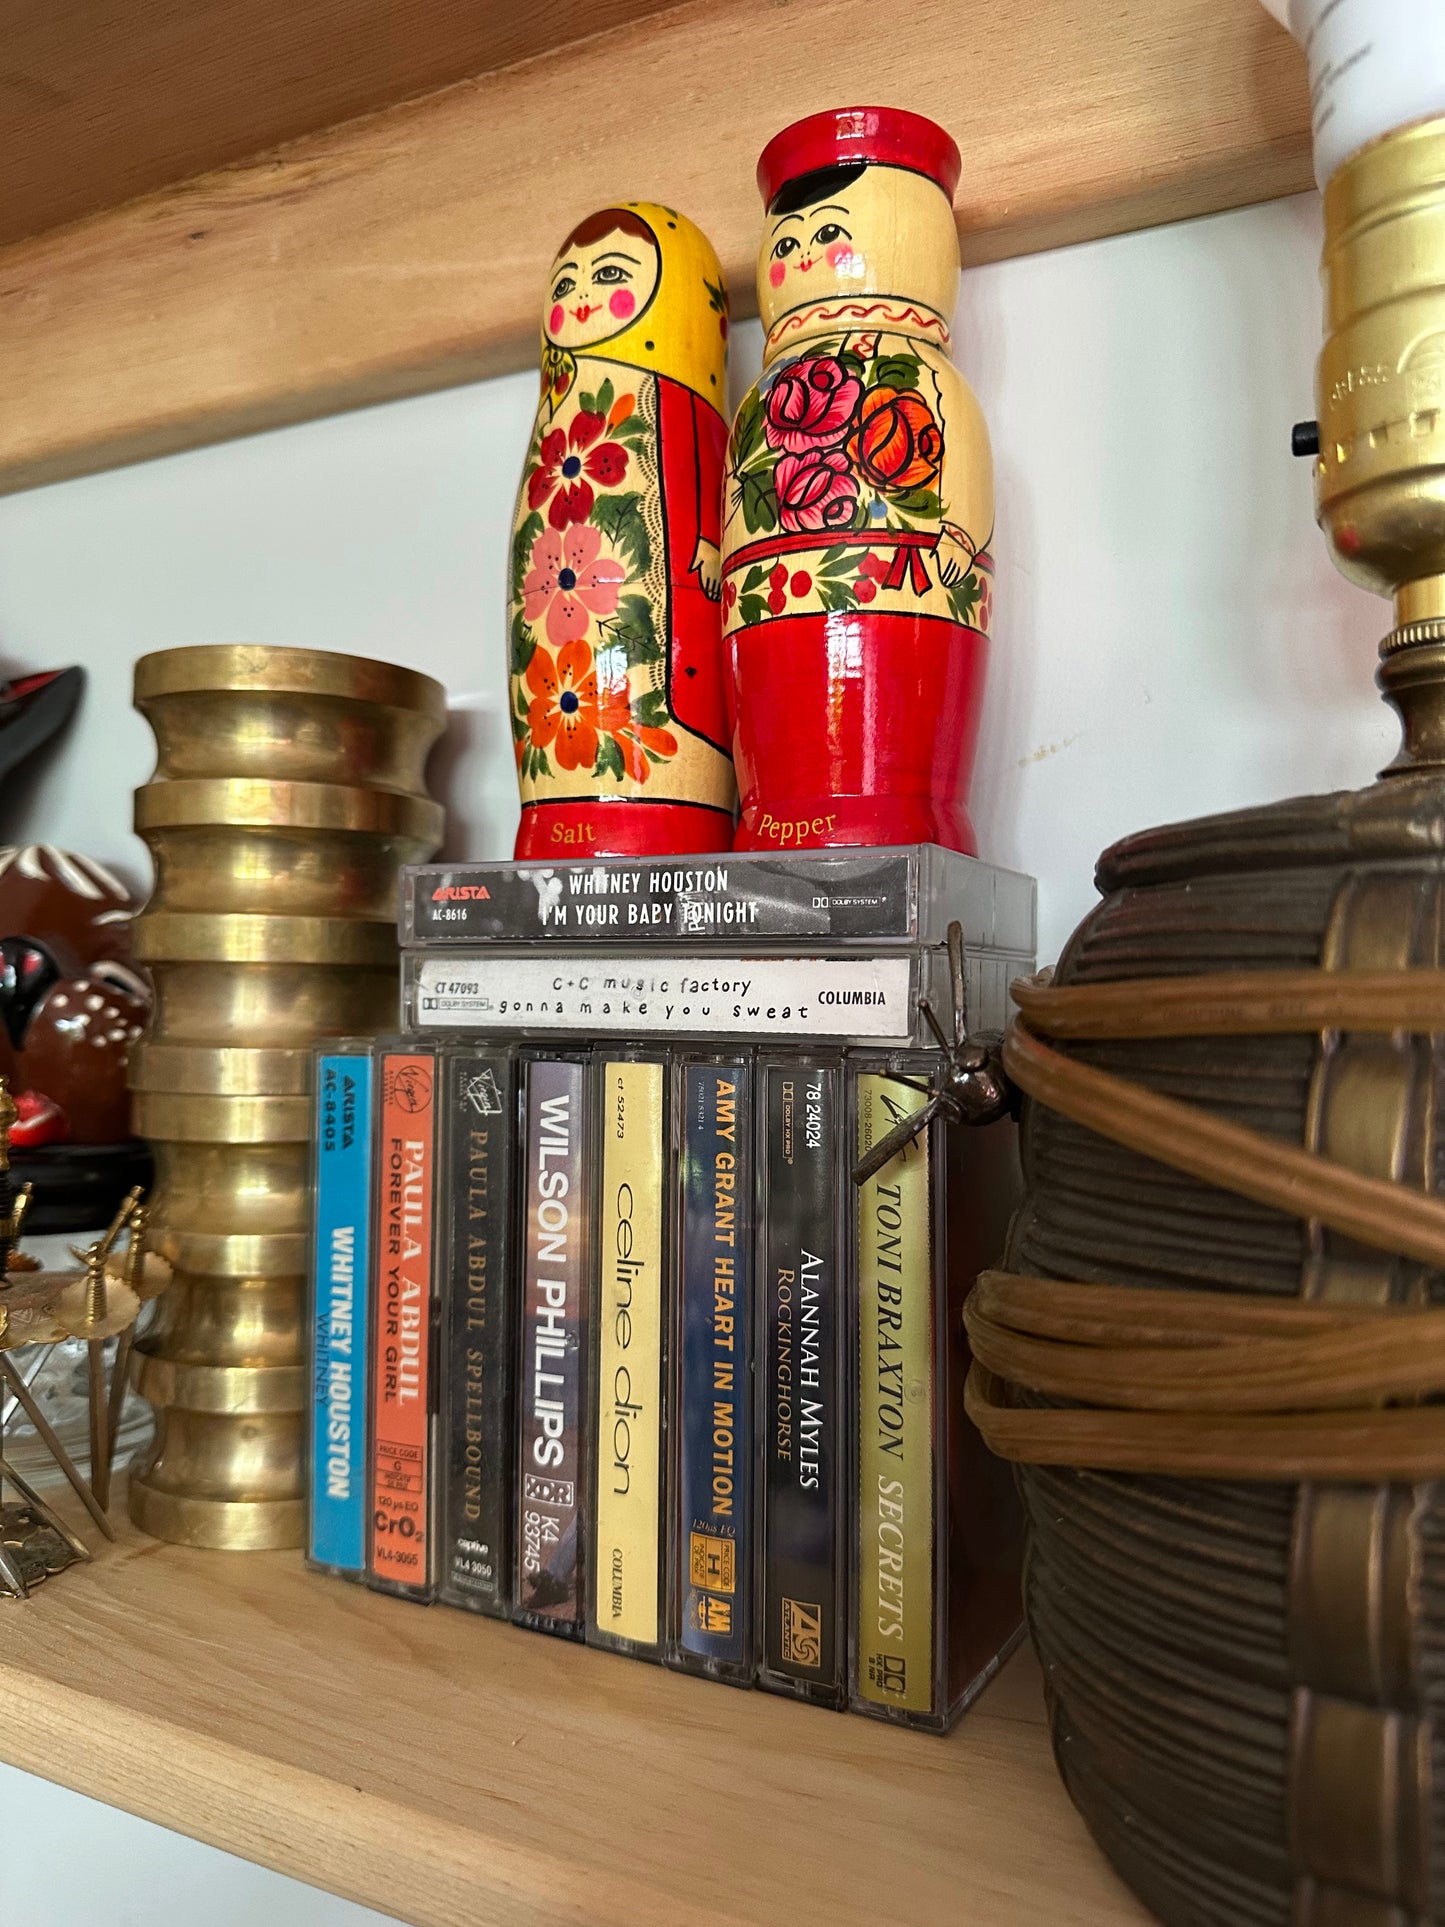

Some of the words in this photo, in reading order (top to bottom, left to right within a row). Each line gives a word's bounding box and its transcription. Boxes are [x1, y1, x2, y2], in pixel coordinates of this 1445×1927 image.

[550, 822, 597, 844] Salt
[757, 813, 837, 846] Pepper
[432, 886, 491, 902] ARISTA
[432, 909, 468, 922] AC-8616
[542, 905, 567, 926] I'M
[575, 904, 624, 926] YOUR
[628, 903, 673, 925] BABY
[680, 901, 758, 924] TONIGHT
[569, 872, 641, 895] WHITNEY
[649, 867, 728, 894] HOUSTON
[435, 982, 446, 994] CT
[449, 982, 479, 995] 47093
[499, 1001, 564, 1015] gonna
[580, 999, 648, 1015] make
[665, 1004, 710, 1019] you
[733, 1005, 808, 1019] sweat
[603, 976, 669, 993] music
[680, 977, 752, 998] factory
[818, 991, 886, 1006] COLUMBIA
[325, 1069, 337, 1152] AC-8405
[343, 1075, 356, 1150] ARISTA
[617, 1096, 625, 1139] 52473
[715, 1079, 736, 1142] AMY
[806, 1082, 822, 1101] 78
[806, 1104, 822, 1149] 24024
[785, 1129, 791, 1139] HX
[389, 1138, 403, 1255] FOREVER
[403, 1139, 425, 1260] PAULA
[469, 1130, 489, 1220] PAULA
[537, 1095, 570, 1262] WILSON
[715, 1152, 735, 1247] GRANT
[615, 1183, 644, 1349] celine
[876, 1183, 903, 1274] TONI
[329, 1226, 355, 1354] WHITNEY
[386, 1266, 400, 1335] YOUR
[467, 1235, 487, 1331] ABDUL
[714, 1257, 735, 1352] HEART
[800, 1248, 824, 1388] ALANNAH
[316, 1313, 329, 1408] WHITNEY
[385, 1346, 398, 1403] GIRL
[399, 1276, 422, 1406] ABDUL
[533, 1279, 567, 1467] PHILLIPS
[713, 1361, 734, 1391] IN
[777, 1268, 796, 1461] ROCKINGHORSE
[877, 1280, 904, 1461] BRAXTON
[327, 1361, 352, 1498] HOUSTON
[465, 1348, 483, 1519] SPELLBOUND
[614, 1366, 643, 1495] dion
[712, 1401, 734, 1516] MOTION
[800, 1398, 824, 1489] MYLES
[525, 1510, 541, 1572] 93745
[541, 1516, 560, 1541] K4
[708, 1552, 720, 1576] H
[877, 1475, 904, 1641] SECRETS
[612, 1548, 623, 1618] COLUMBIA
[783, 1600, 791, 1659] ATLANTIC
